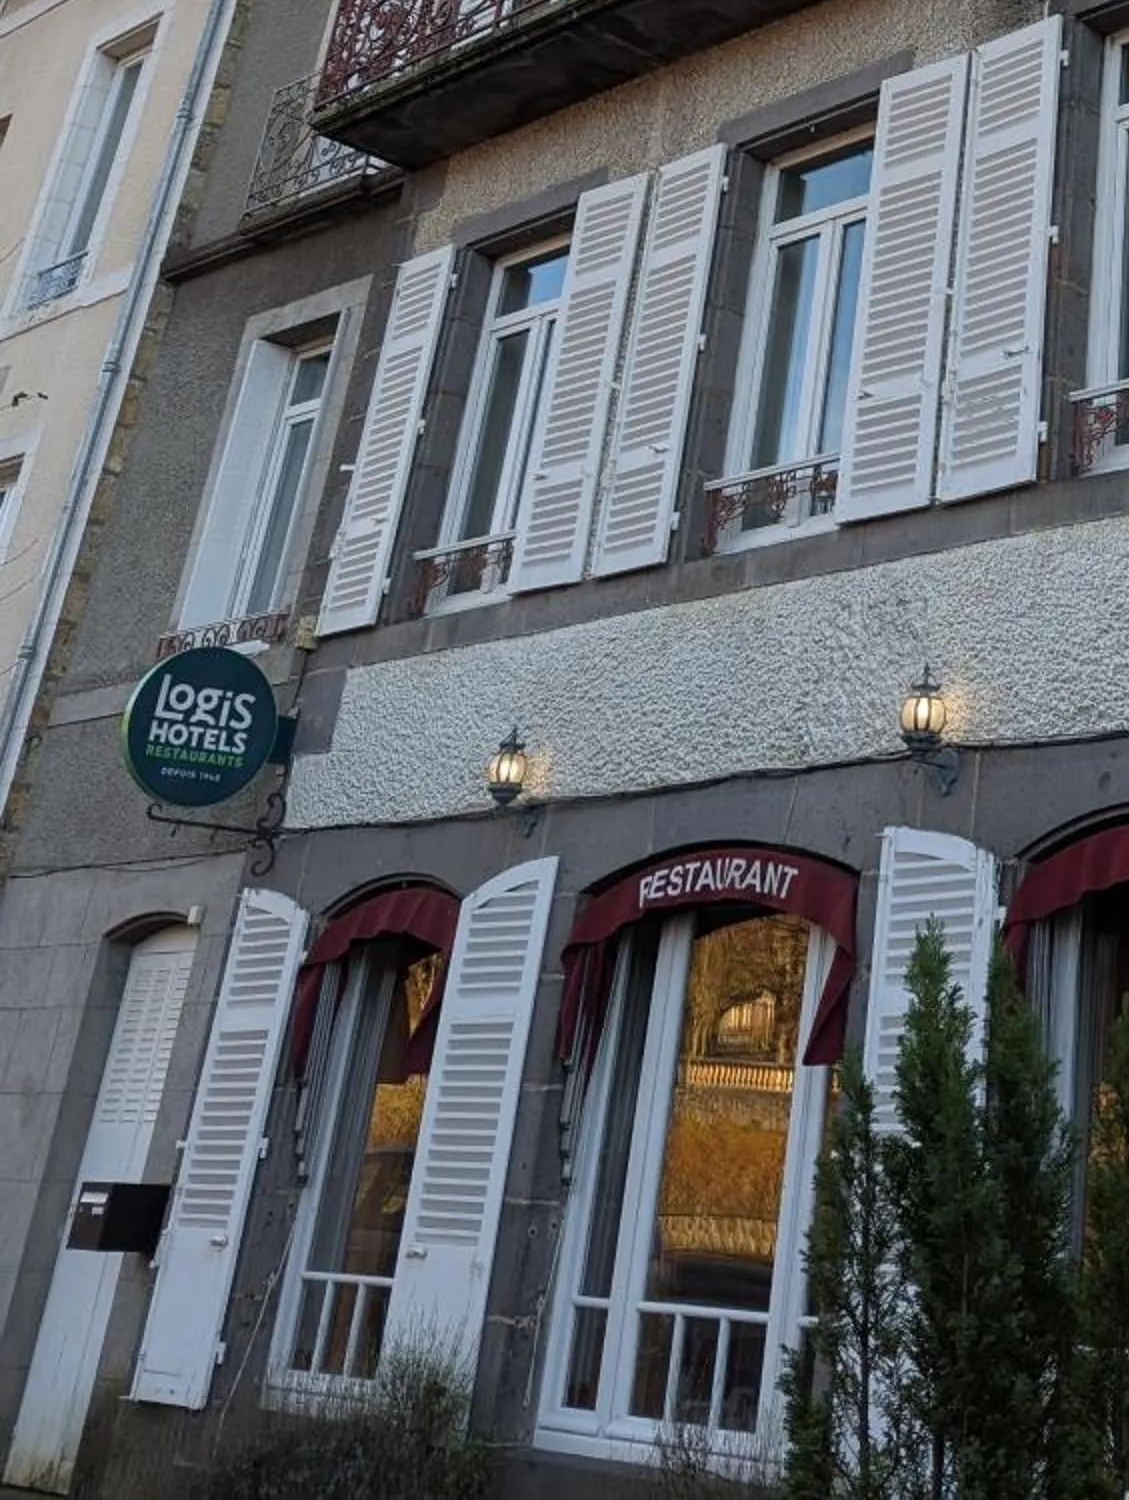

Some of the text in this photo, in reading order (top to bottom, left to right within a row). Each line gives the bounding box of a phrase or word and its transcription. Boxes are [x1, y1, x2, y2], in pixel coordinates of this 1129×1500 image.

[148, 719, 249, 754] HOTELS
[145, 743, 244, 768] RESTAURANTS
[638, 856, 799, 909] RESTAURANT
